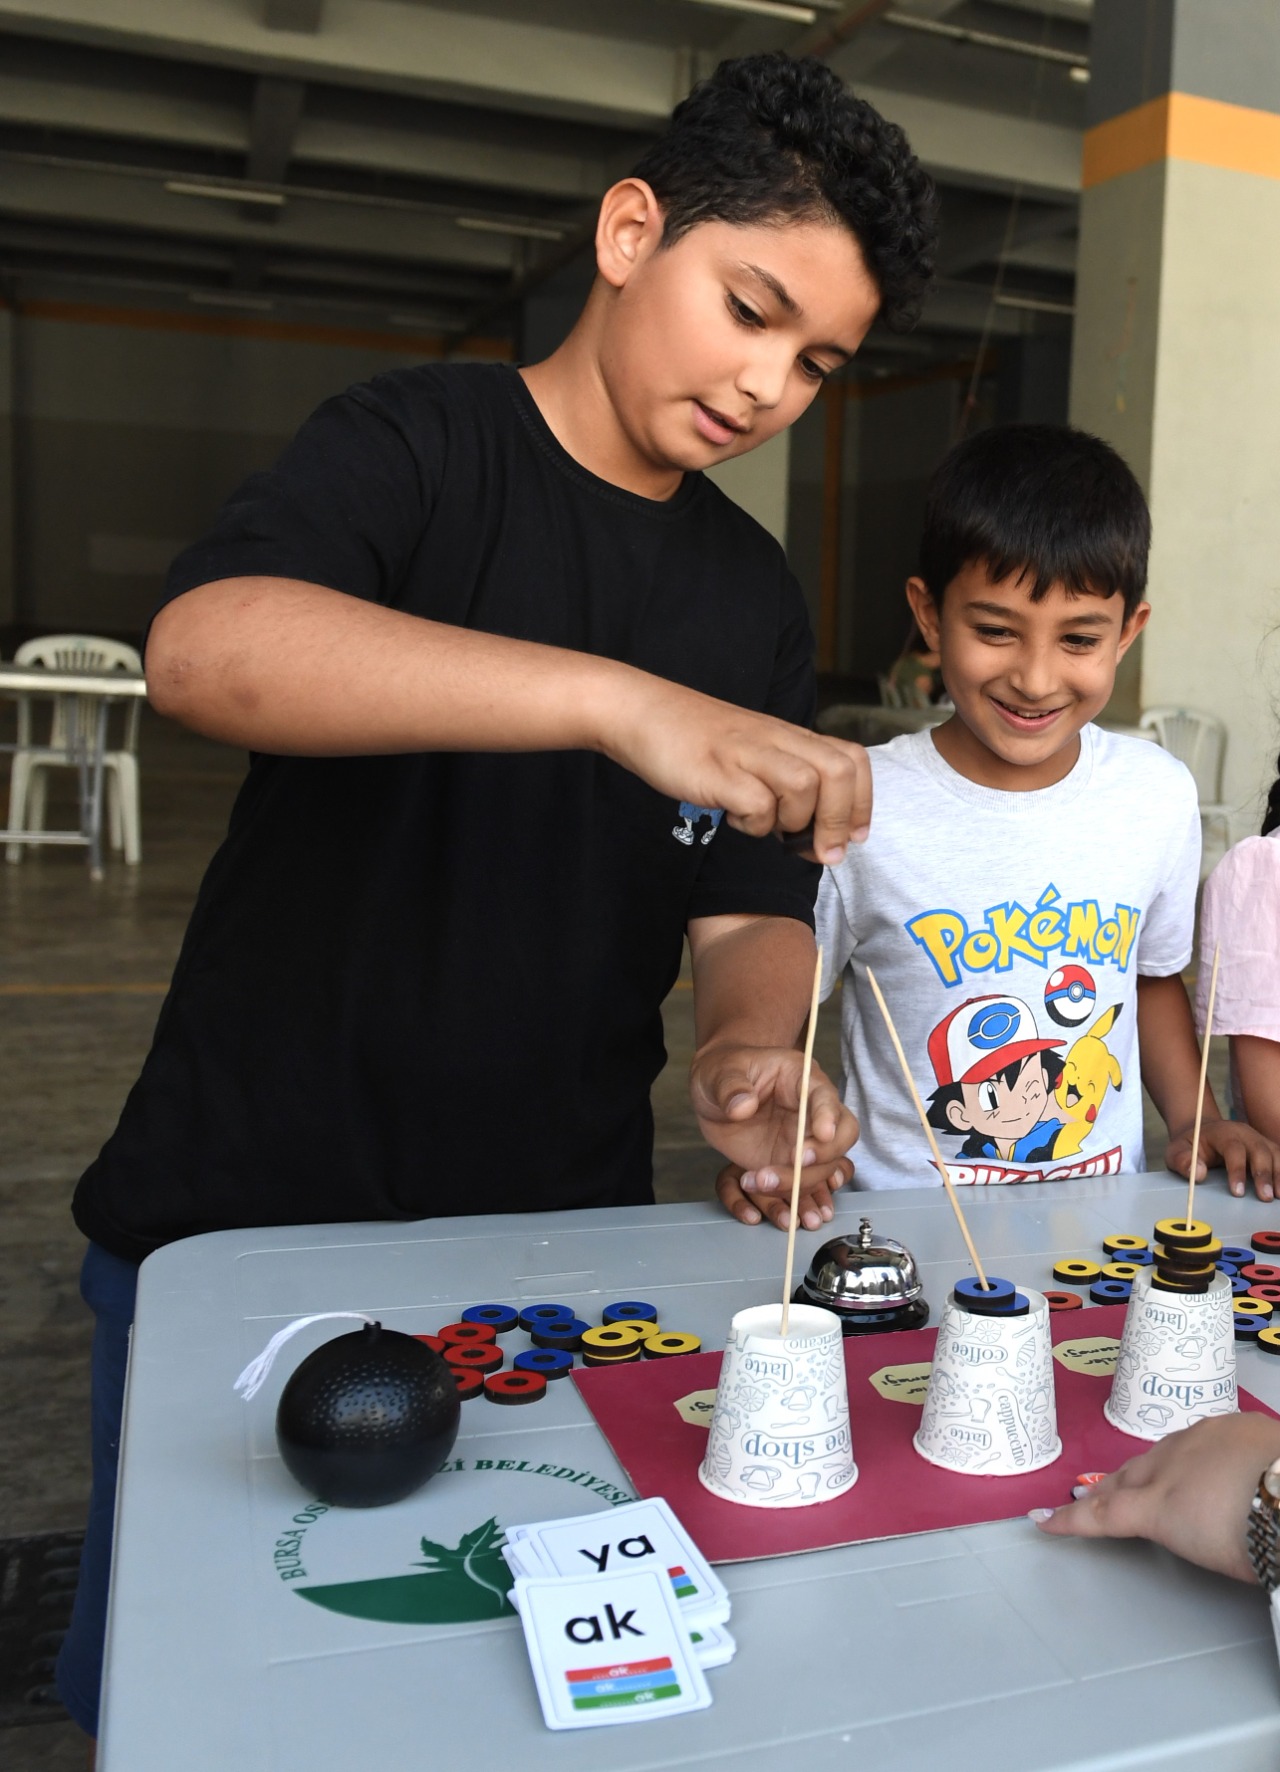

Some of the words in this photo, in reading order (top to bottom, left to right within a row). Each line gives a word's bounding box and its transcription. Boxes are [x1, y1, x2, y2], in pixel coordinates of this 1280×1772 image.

[1145, 1307, 1183, 1330] latte
[952, 1341, 1005, 1364] coffee
[745, 1357, 789, 1381] latte
[1143, 1375, 1204, 1407] shop
[950, 1426, 988, 1447] latte
[996, 1394, 1026, 1468] cappuccino
[745, 1433, 815, 1466] shop
[473, 1459, 642, 1507] BELEDİYESİ
[273, 1527, 308, 1582] BURSA
[577, 1534, 656, 1574] ya
[564, 1603, 646, 1645] ak
[608, 1665, 630, 1678] ak
[595, 1682, 616, 1695] ak
[634, 1691, 656, 1704] ak
